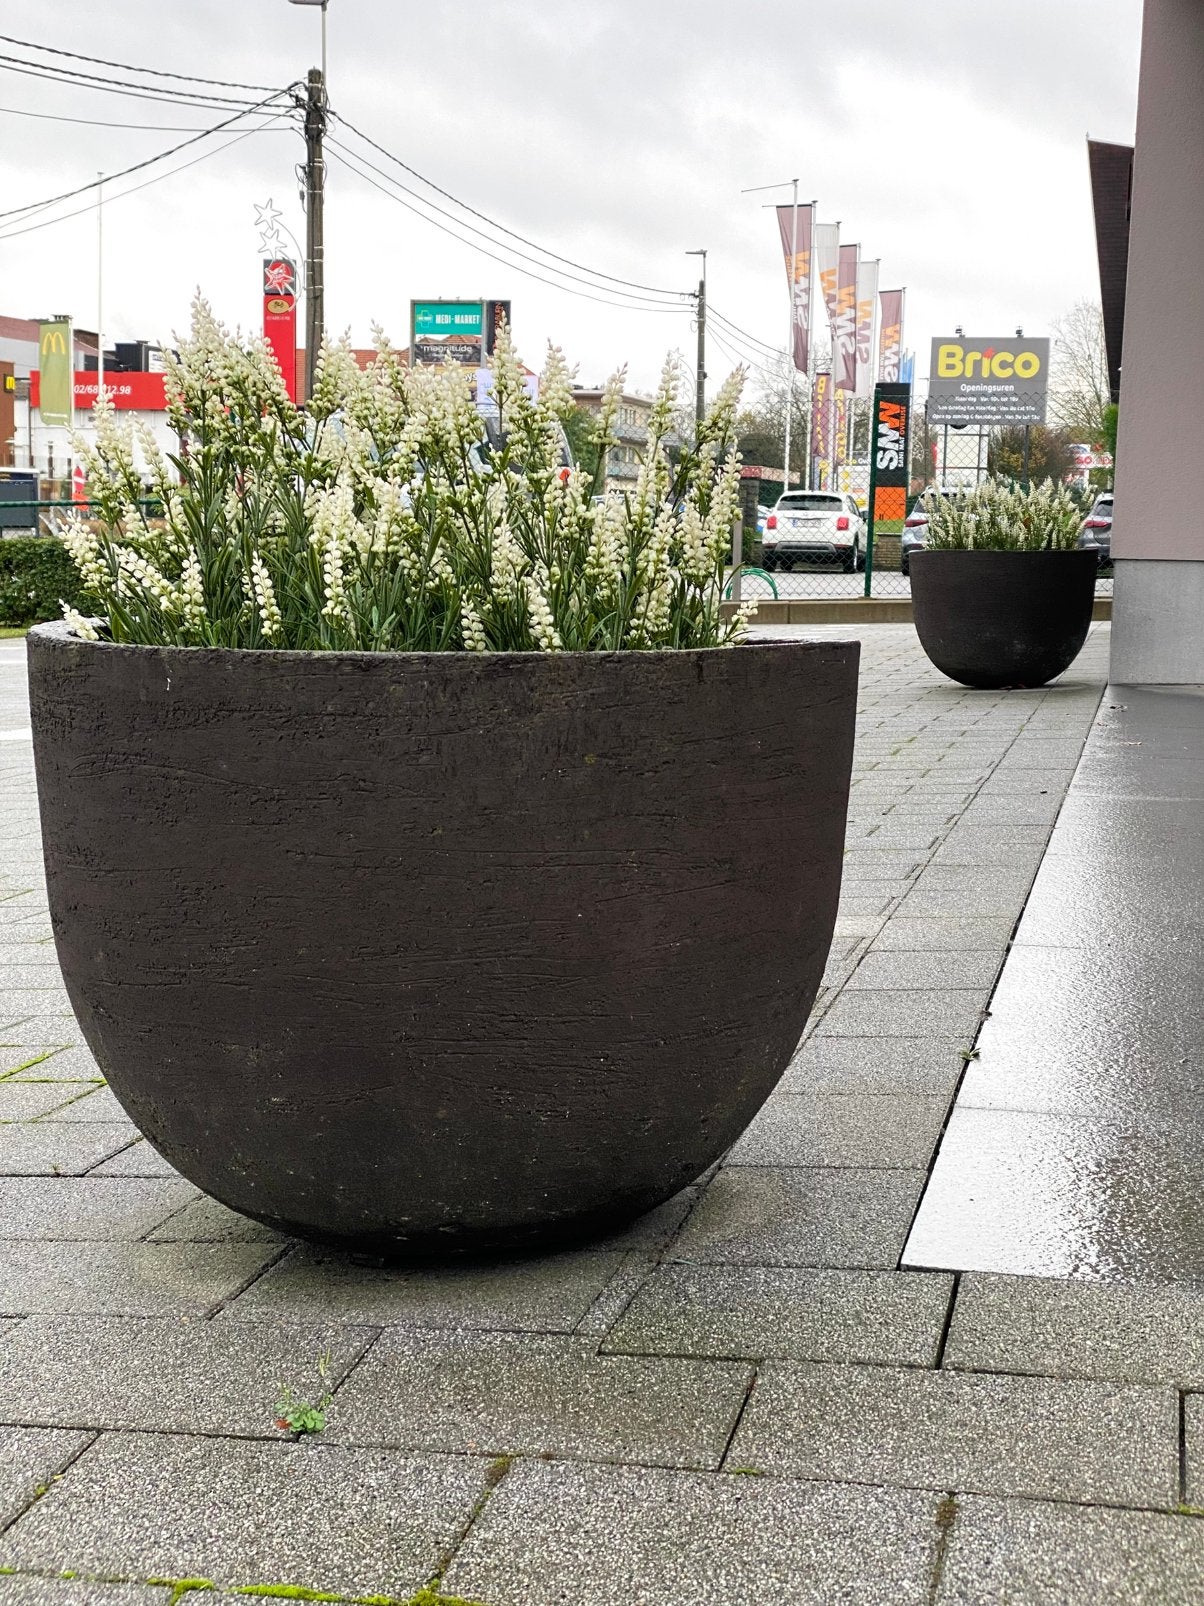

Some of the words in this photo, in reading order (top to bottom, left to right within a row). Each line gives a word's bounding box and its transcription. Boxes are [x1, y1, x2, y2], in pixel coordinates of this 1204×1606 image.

[423, 344, 473, 353] magnitude
[937, 344, 1041, 379] Brico
[960, 383, 1014, 393] Openingsuren
[878, 401, 900, 470] SMW
